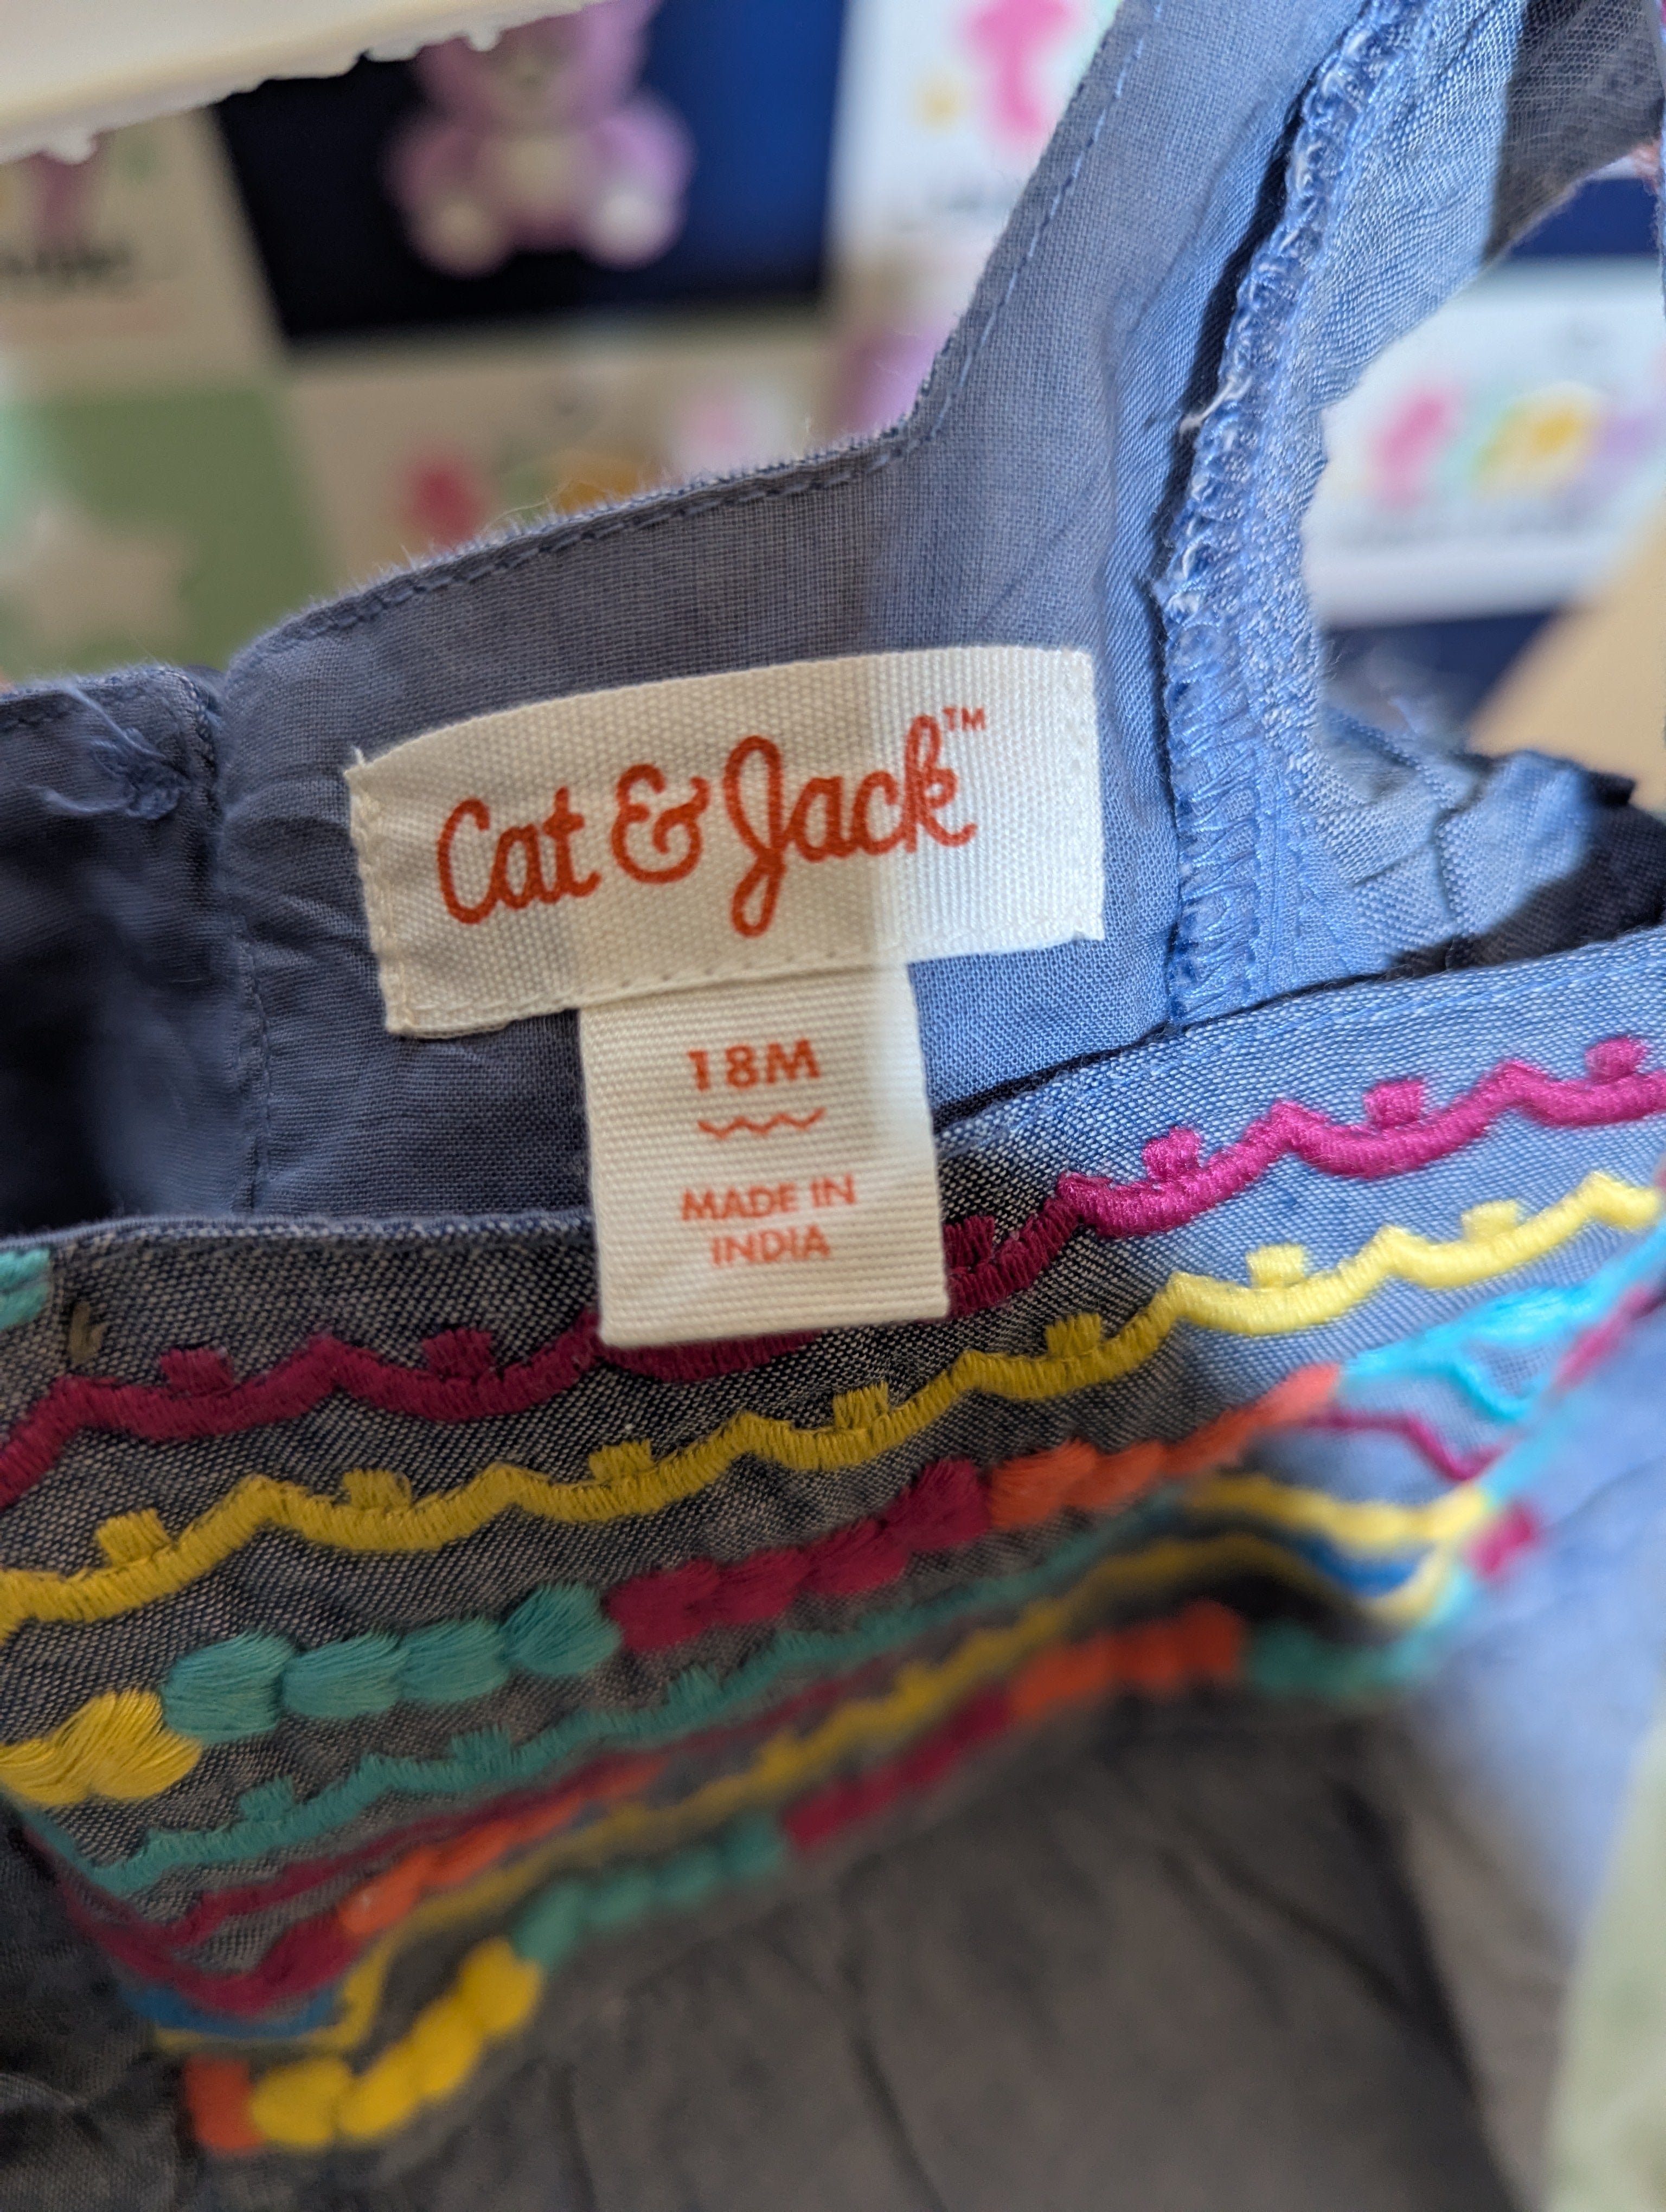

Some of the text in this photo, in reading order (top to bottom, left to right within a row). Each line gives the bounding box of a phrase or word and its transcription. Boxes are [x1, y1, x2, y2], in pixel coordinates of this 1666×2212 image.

[437, 786, 601, 924] Cat
[611, 763, 712, 885] &
[687, 1039, 821, 1093] 18M
[681, 1174, 856, 1222] MADE IN
[711, 1225, 831, 1264] INDIA
